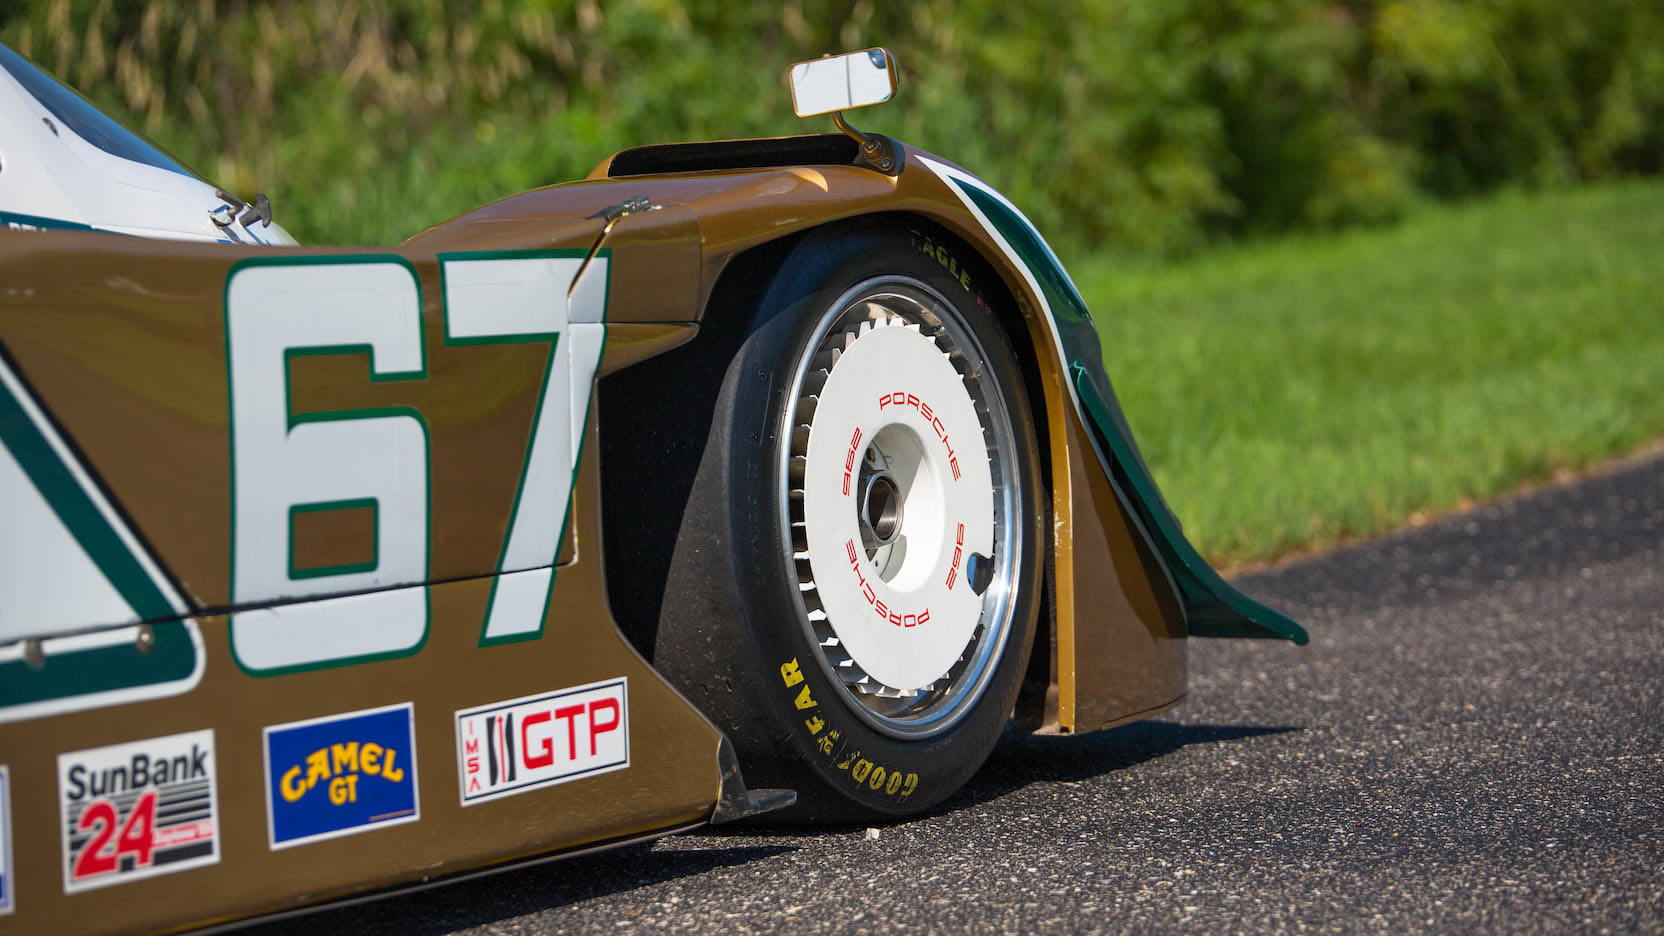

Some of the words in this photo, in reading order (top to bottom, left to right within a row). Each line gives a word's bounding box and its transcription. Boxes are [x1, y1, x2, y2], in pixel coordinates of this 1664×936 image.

[225, 247, 612, 677] 67
[842, 427, 863, 497] 962
[879, 392, 962, 481] PORSCHE
[845, 539, 930, 628] PORSCHE
[945, 522, 965, 590] 962
[465, 719, 482, 792] IMSA
[521, 697, 620, 770] GTP
[67, 744, 209, 801] SunBank
[279, 741, 404, 803] CAMEL
[328, 774, 359, 806] GT
[73, 791, 157, 881] 24
